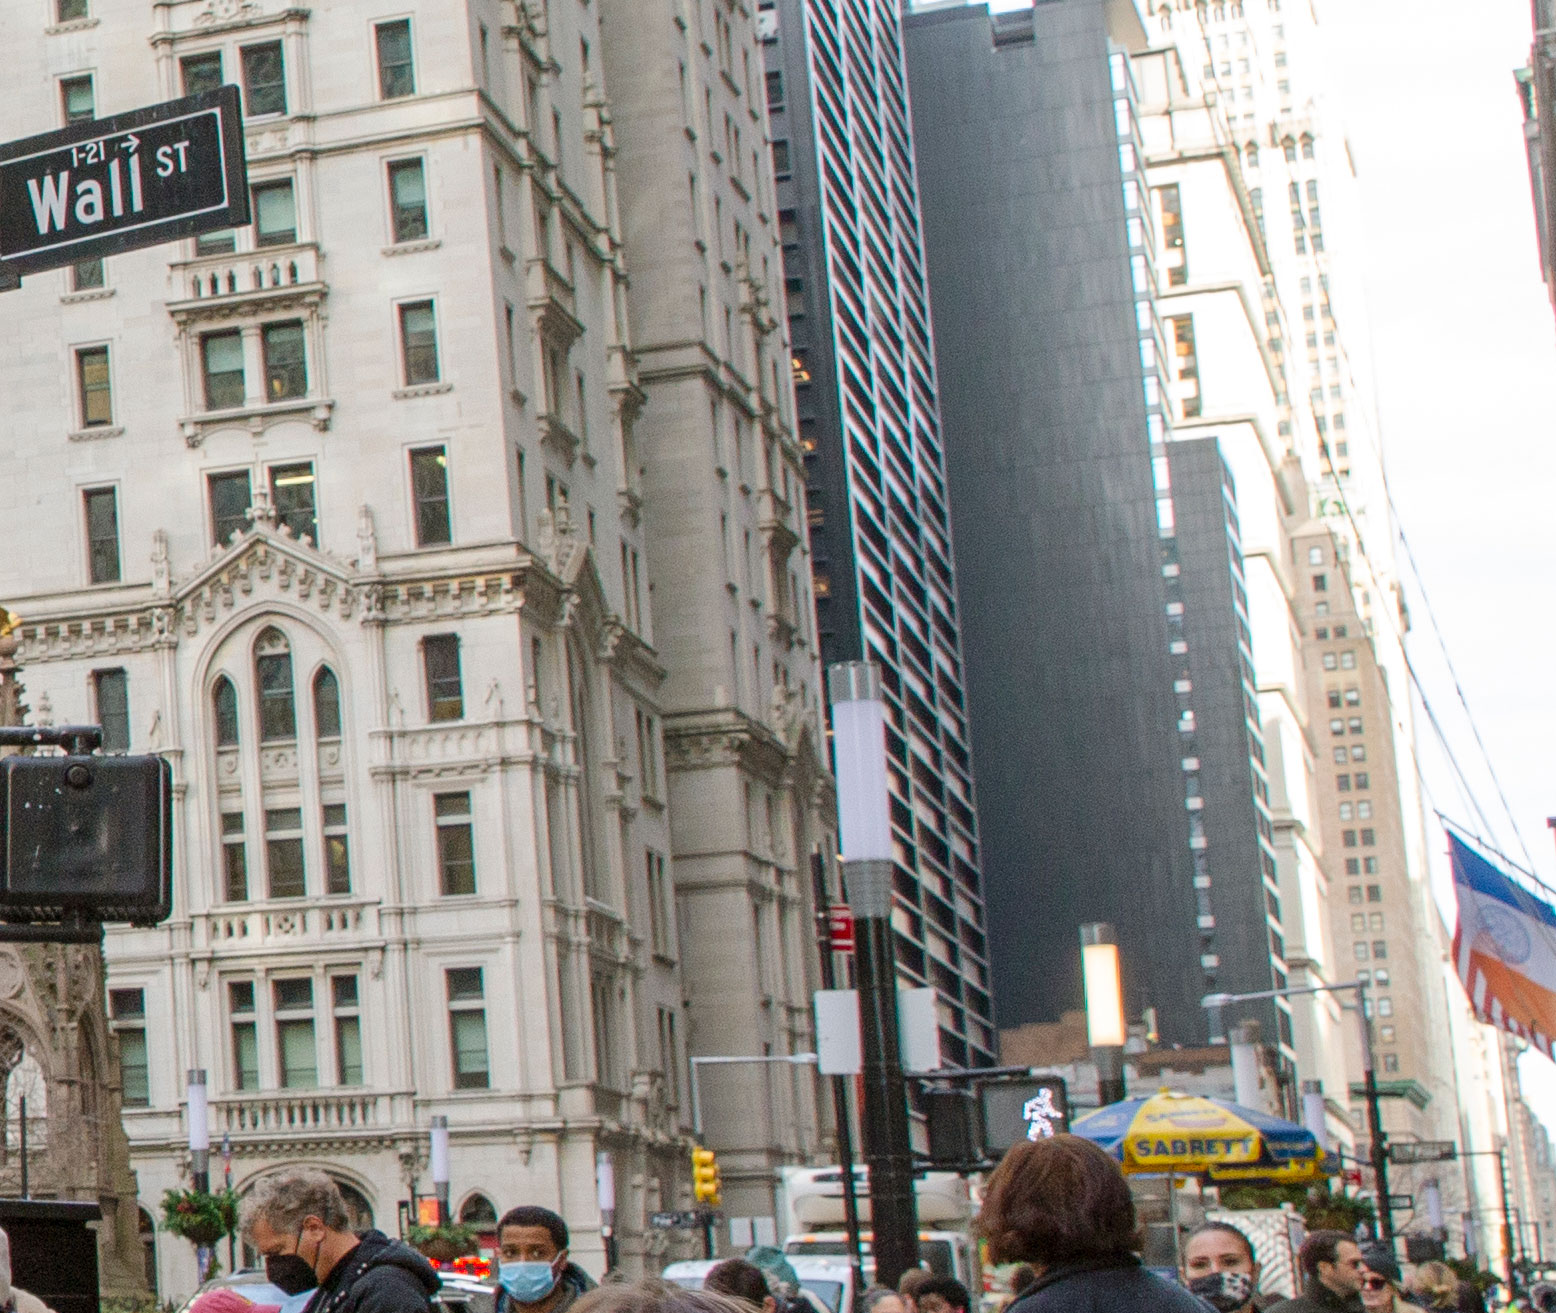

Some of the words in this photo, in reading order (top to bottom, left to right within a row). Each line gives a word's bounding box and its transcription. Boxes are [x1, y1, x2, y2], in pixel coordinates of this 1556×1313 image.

[71, 141, 106, 168] 1-21
[27, 152, 144, 235] Wall
[156, 140, 190, 177] ST
[1136, 1139, 1254, 1157] SABRETT
